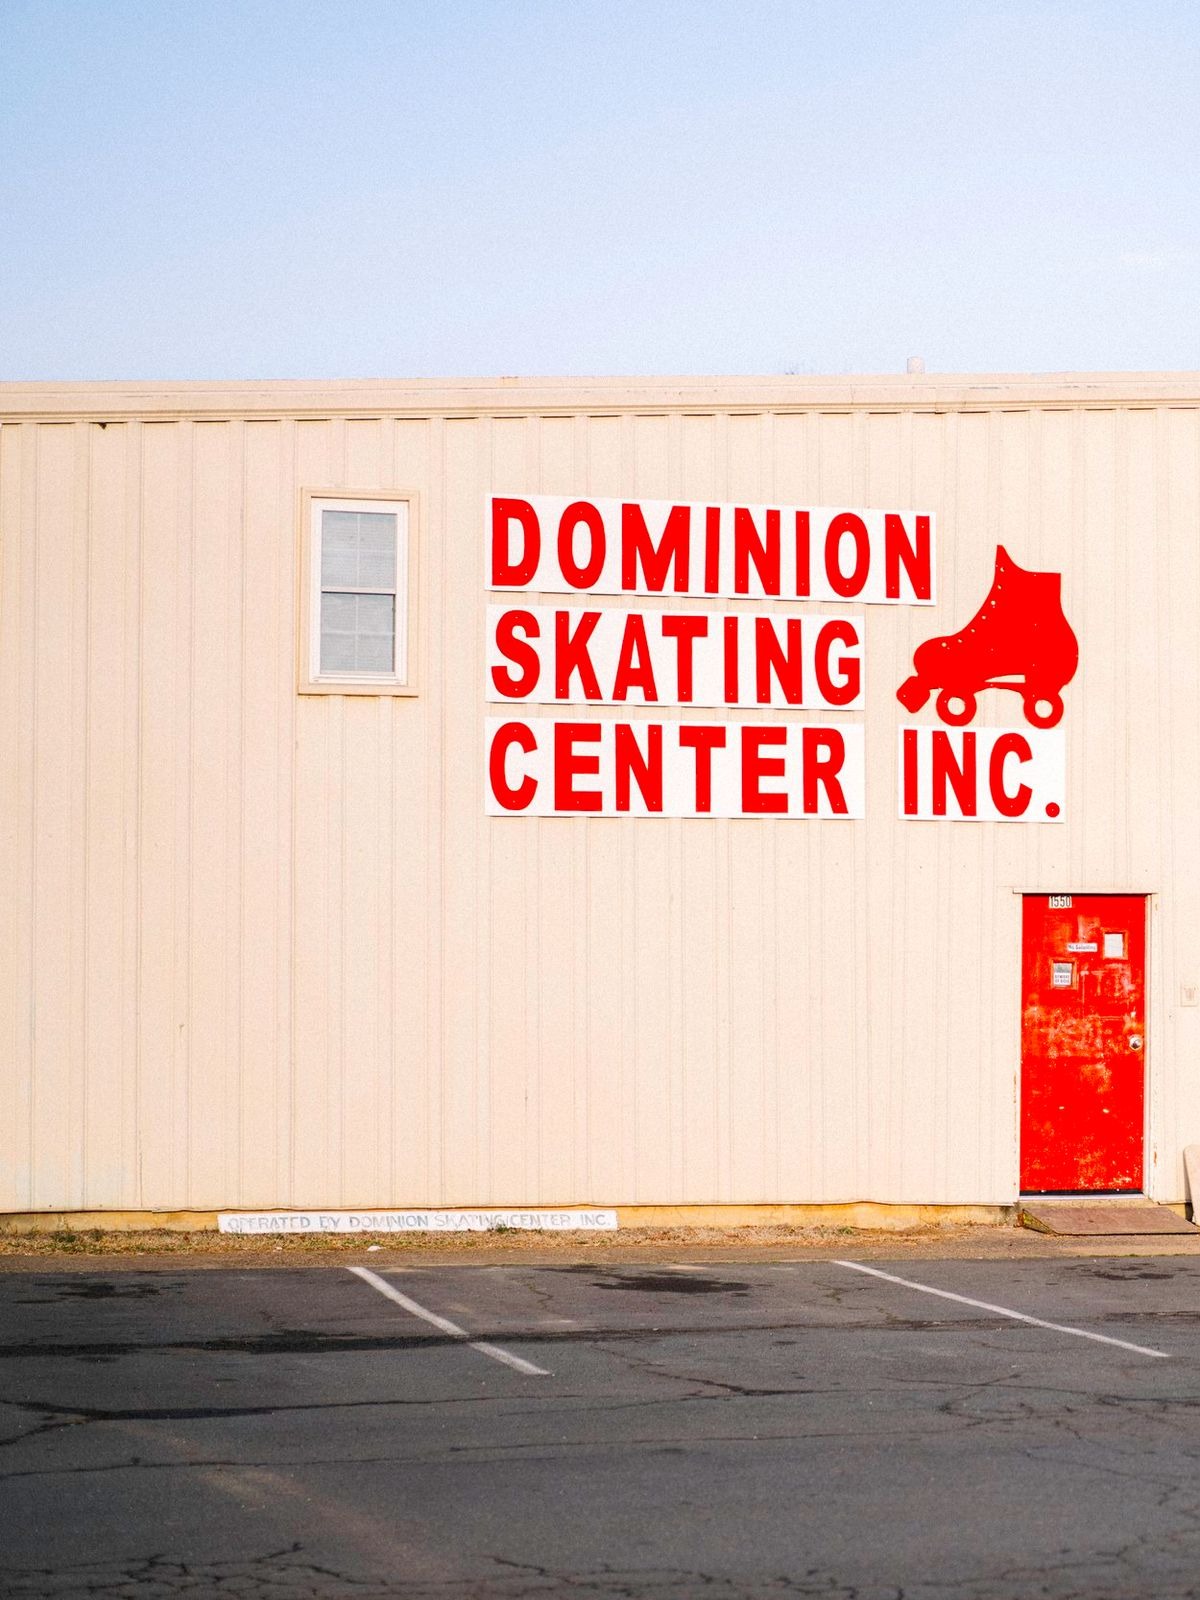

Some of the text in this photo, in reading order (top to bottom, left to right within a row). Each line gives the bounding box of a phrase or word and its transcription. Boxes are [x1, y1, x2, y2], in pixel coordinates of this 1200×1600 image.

[491, 497, 931, 601] DOMINION
[491, 609, 861, 706] SKATING
[489, 721, 1061, 818] CENTER INC.
[1050, 896, 1071, 907] 1550
[228, 1216, 311, 1230] OPERATED
[349, 1215, 429, 1229] DOMINION
[434, 1214, 505, 1228] SKATING
[508, 1214, 571, 1228] CENTER
[580, 1213, 611, 1227] INC.
